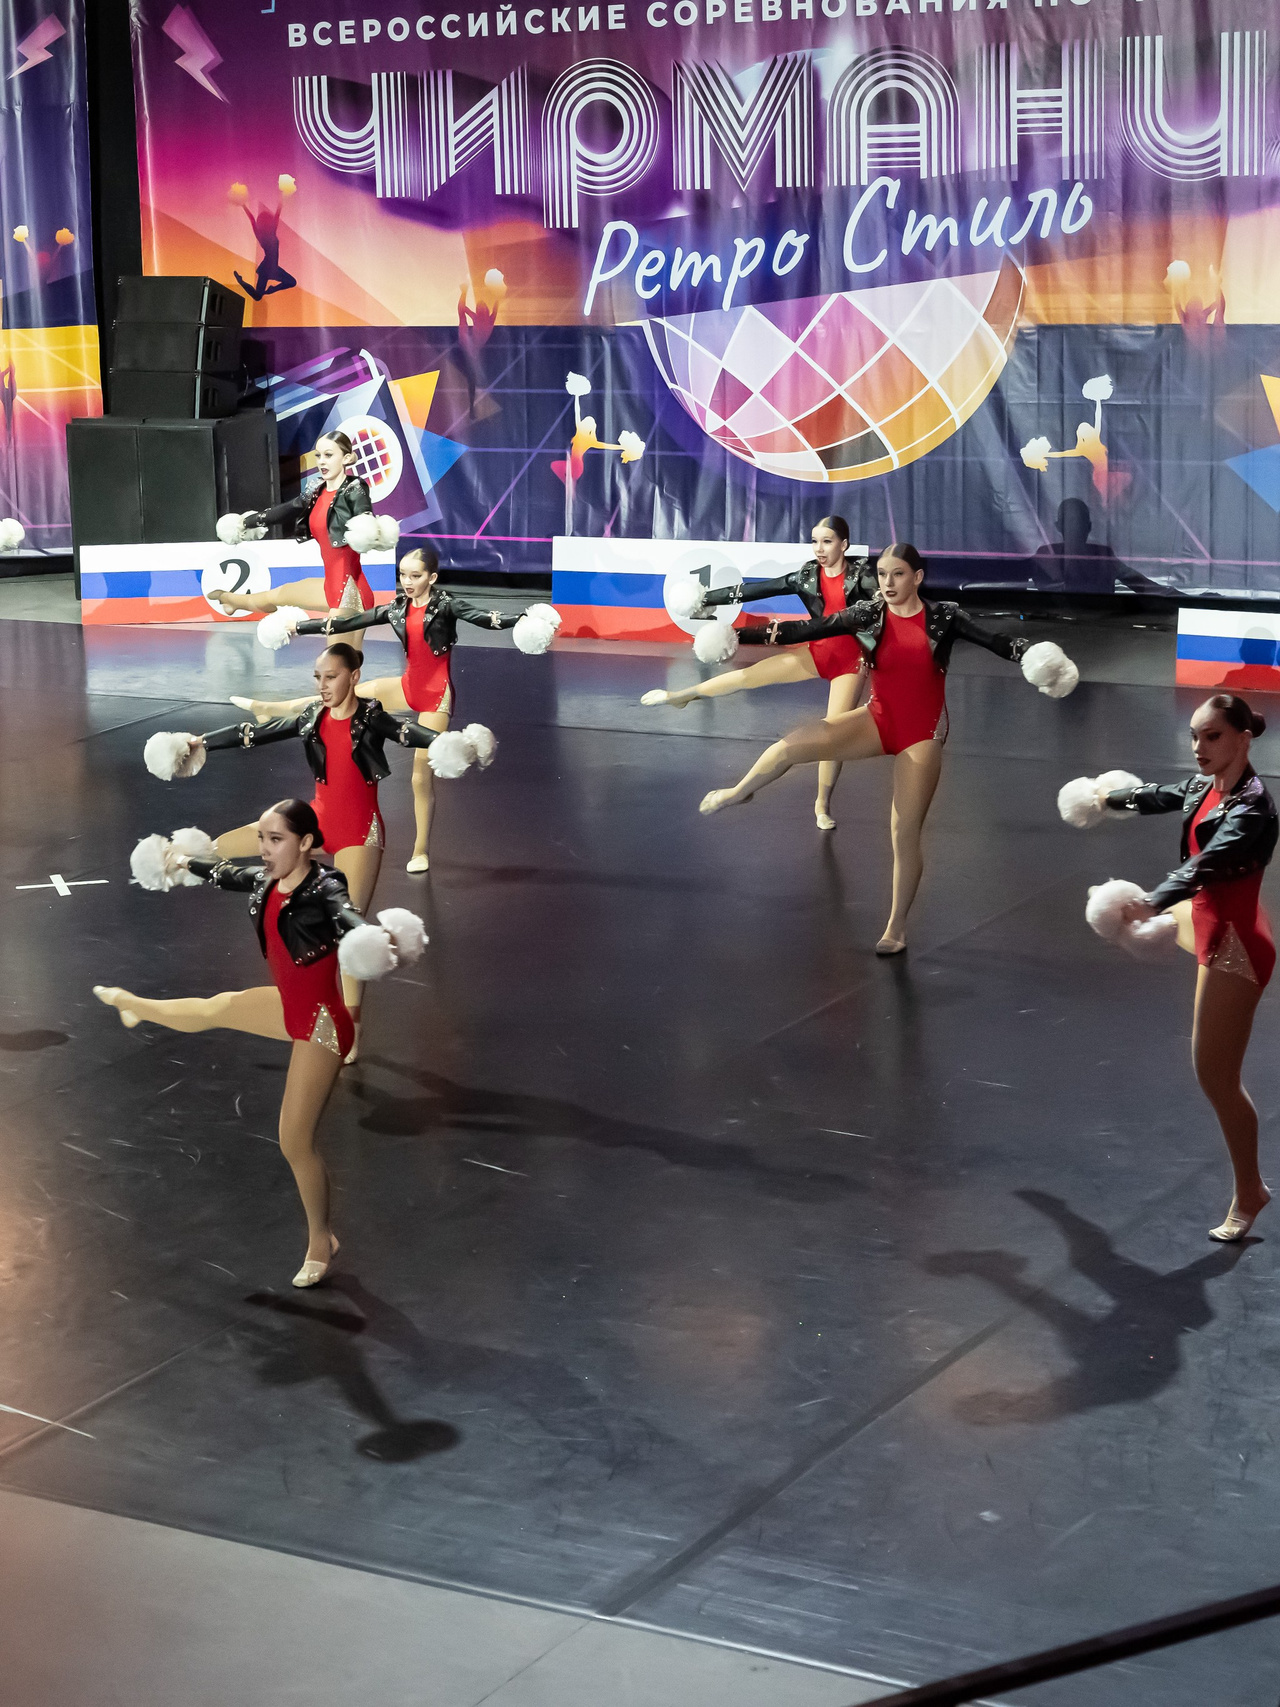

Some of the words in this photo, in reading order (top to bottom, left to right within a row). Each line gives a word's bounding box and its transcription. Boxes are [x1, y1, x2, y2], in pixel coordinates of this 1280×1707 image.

[288, 4, 626, 47] ВСЕРОССИЙСКИЕ
[292, 30, 1280, 228] ЧИРМАНИ
[583, 220, 812, 317] Ретро
[842, 176, 1095, 274] Стиль
[219, 558, 251, 604] 2
